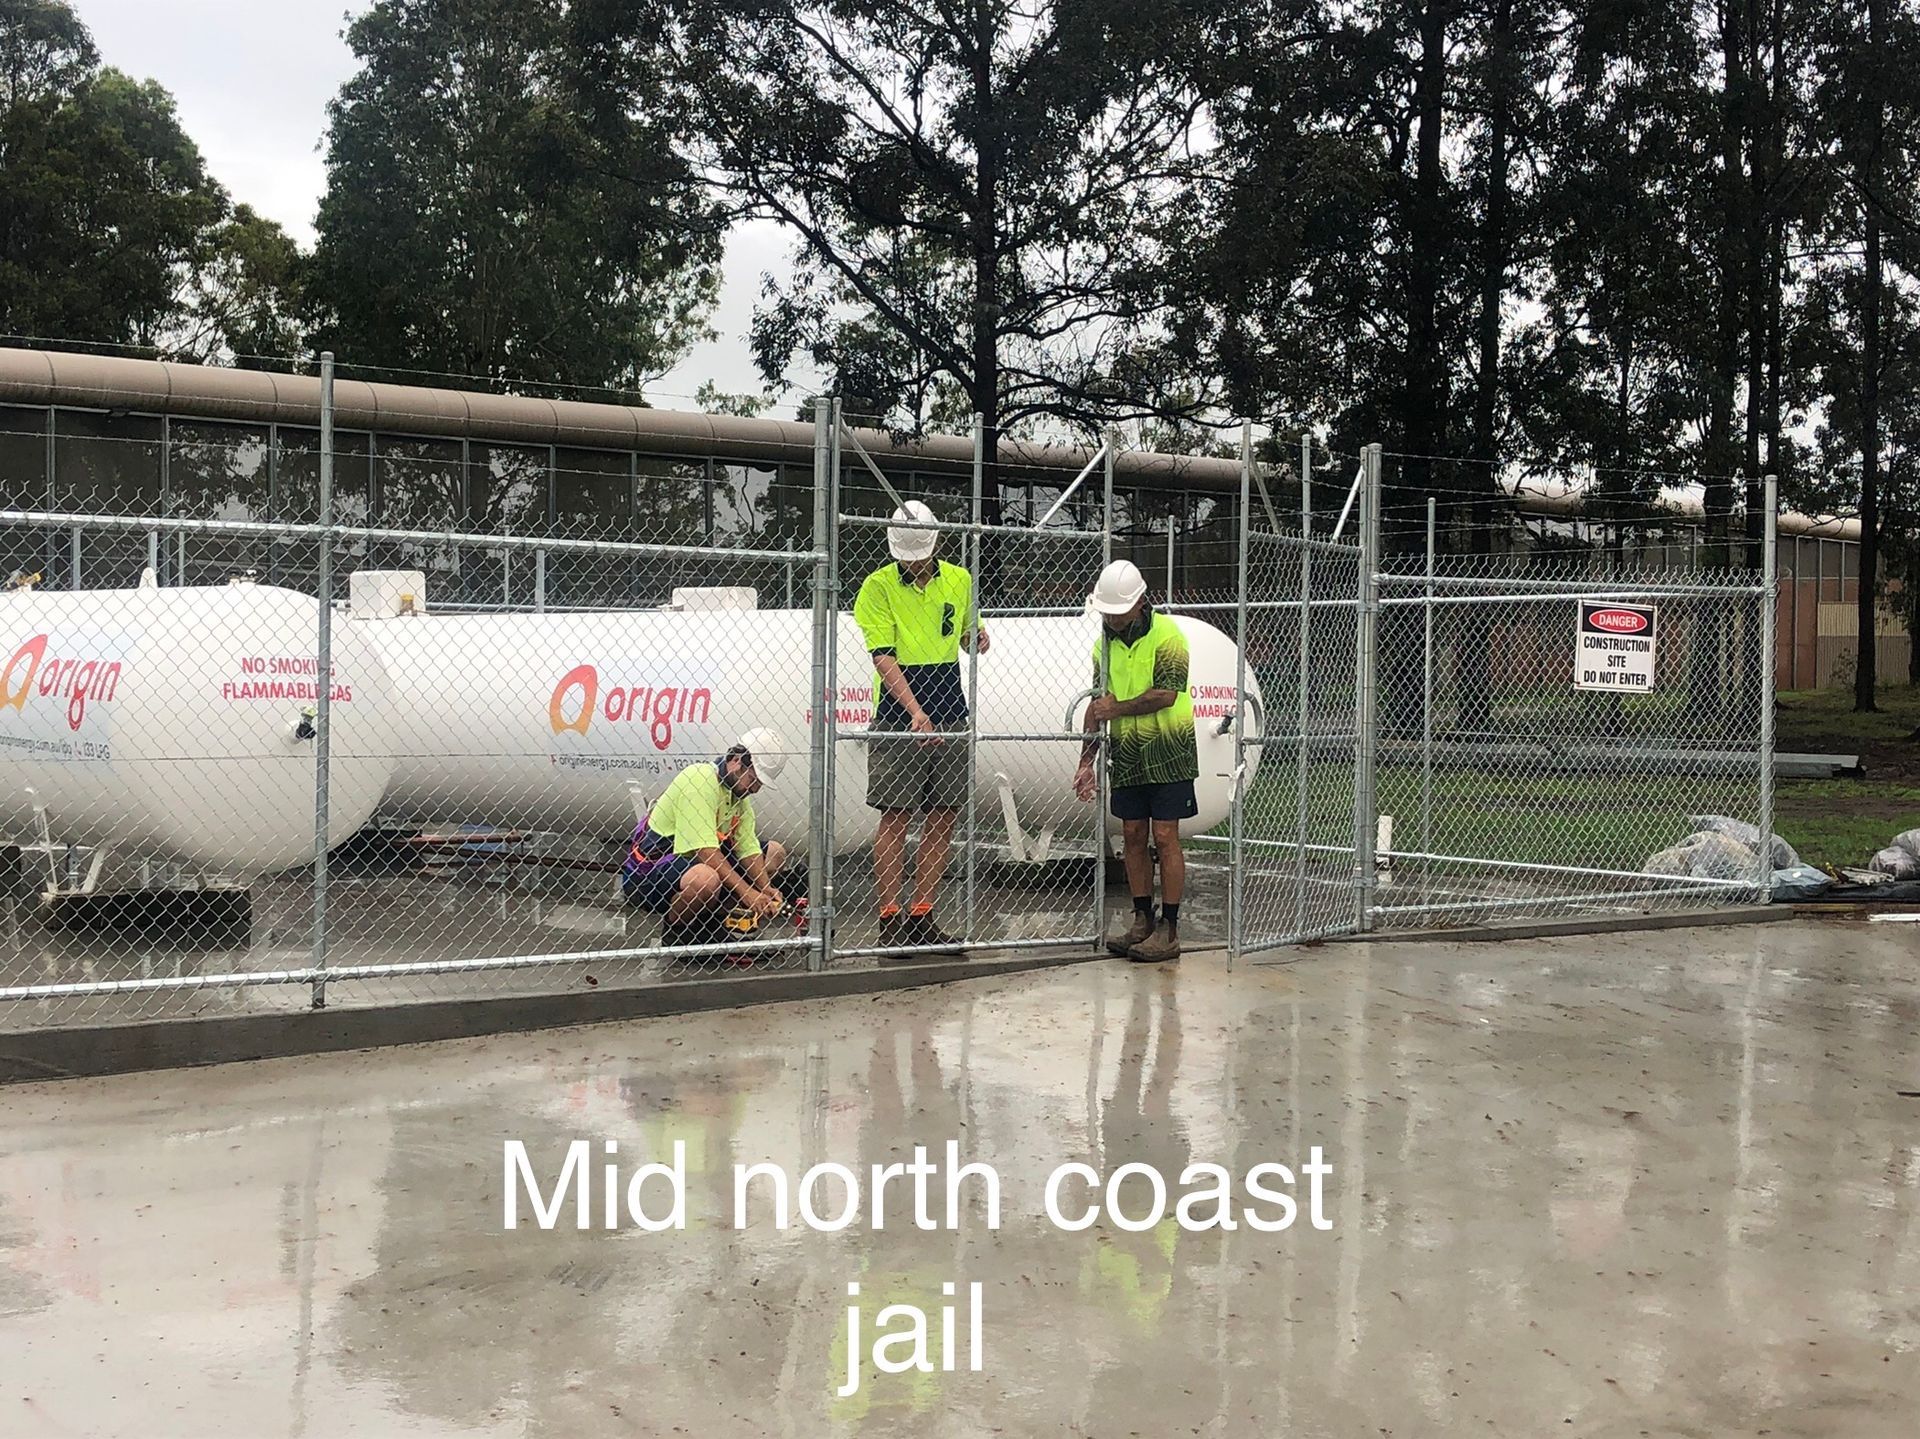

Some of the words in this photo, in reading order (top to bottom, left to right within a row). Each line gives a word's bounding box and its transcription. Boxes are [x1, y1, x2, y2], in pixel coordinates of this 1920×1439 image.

[1599, 614, 1638, 628] DANGER
[1583, 636, 1650, 653] CONSTRUCTION
[241, 657, 266, 673] NO
[269, 658, 335, 676] SMOKIG
[1607, 655, 1626, 668] SITE
[1583, 671, 1596, 683] DO
[1599, 671, 1617, 684] NOT
[1619, 672, 1647, 686] ENTER
[39, 659, 121, 731] origin
[604, 687, 711, 750] origin
